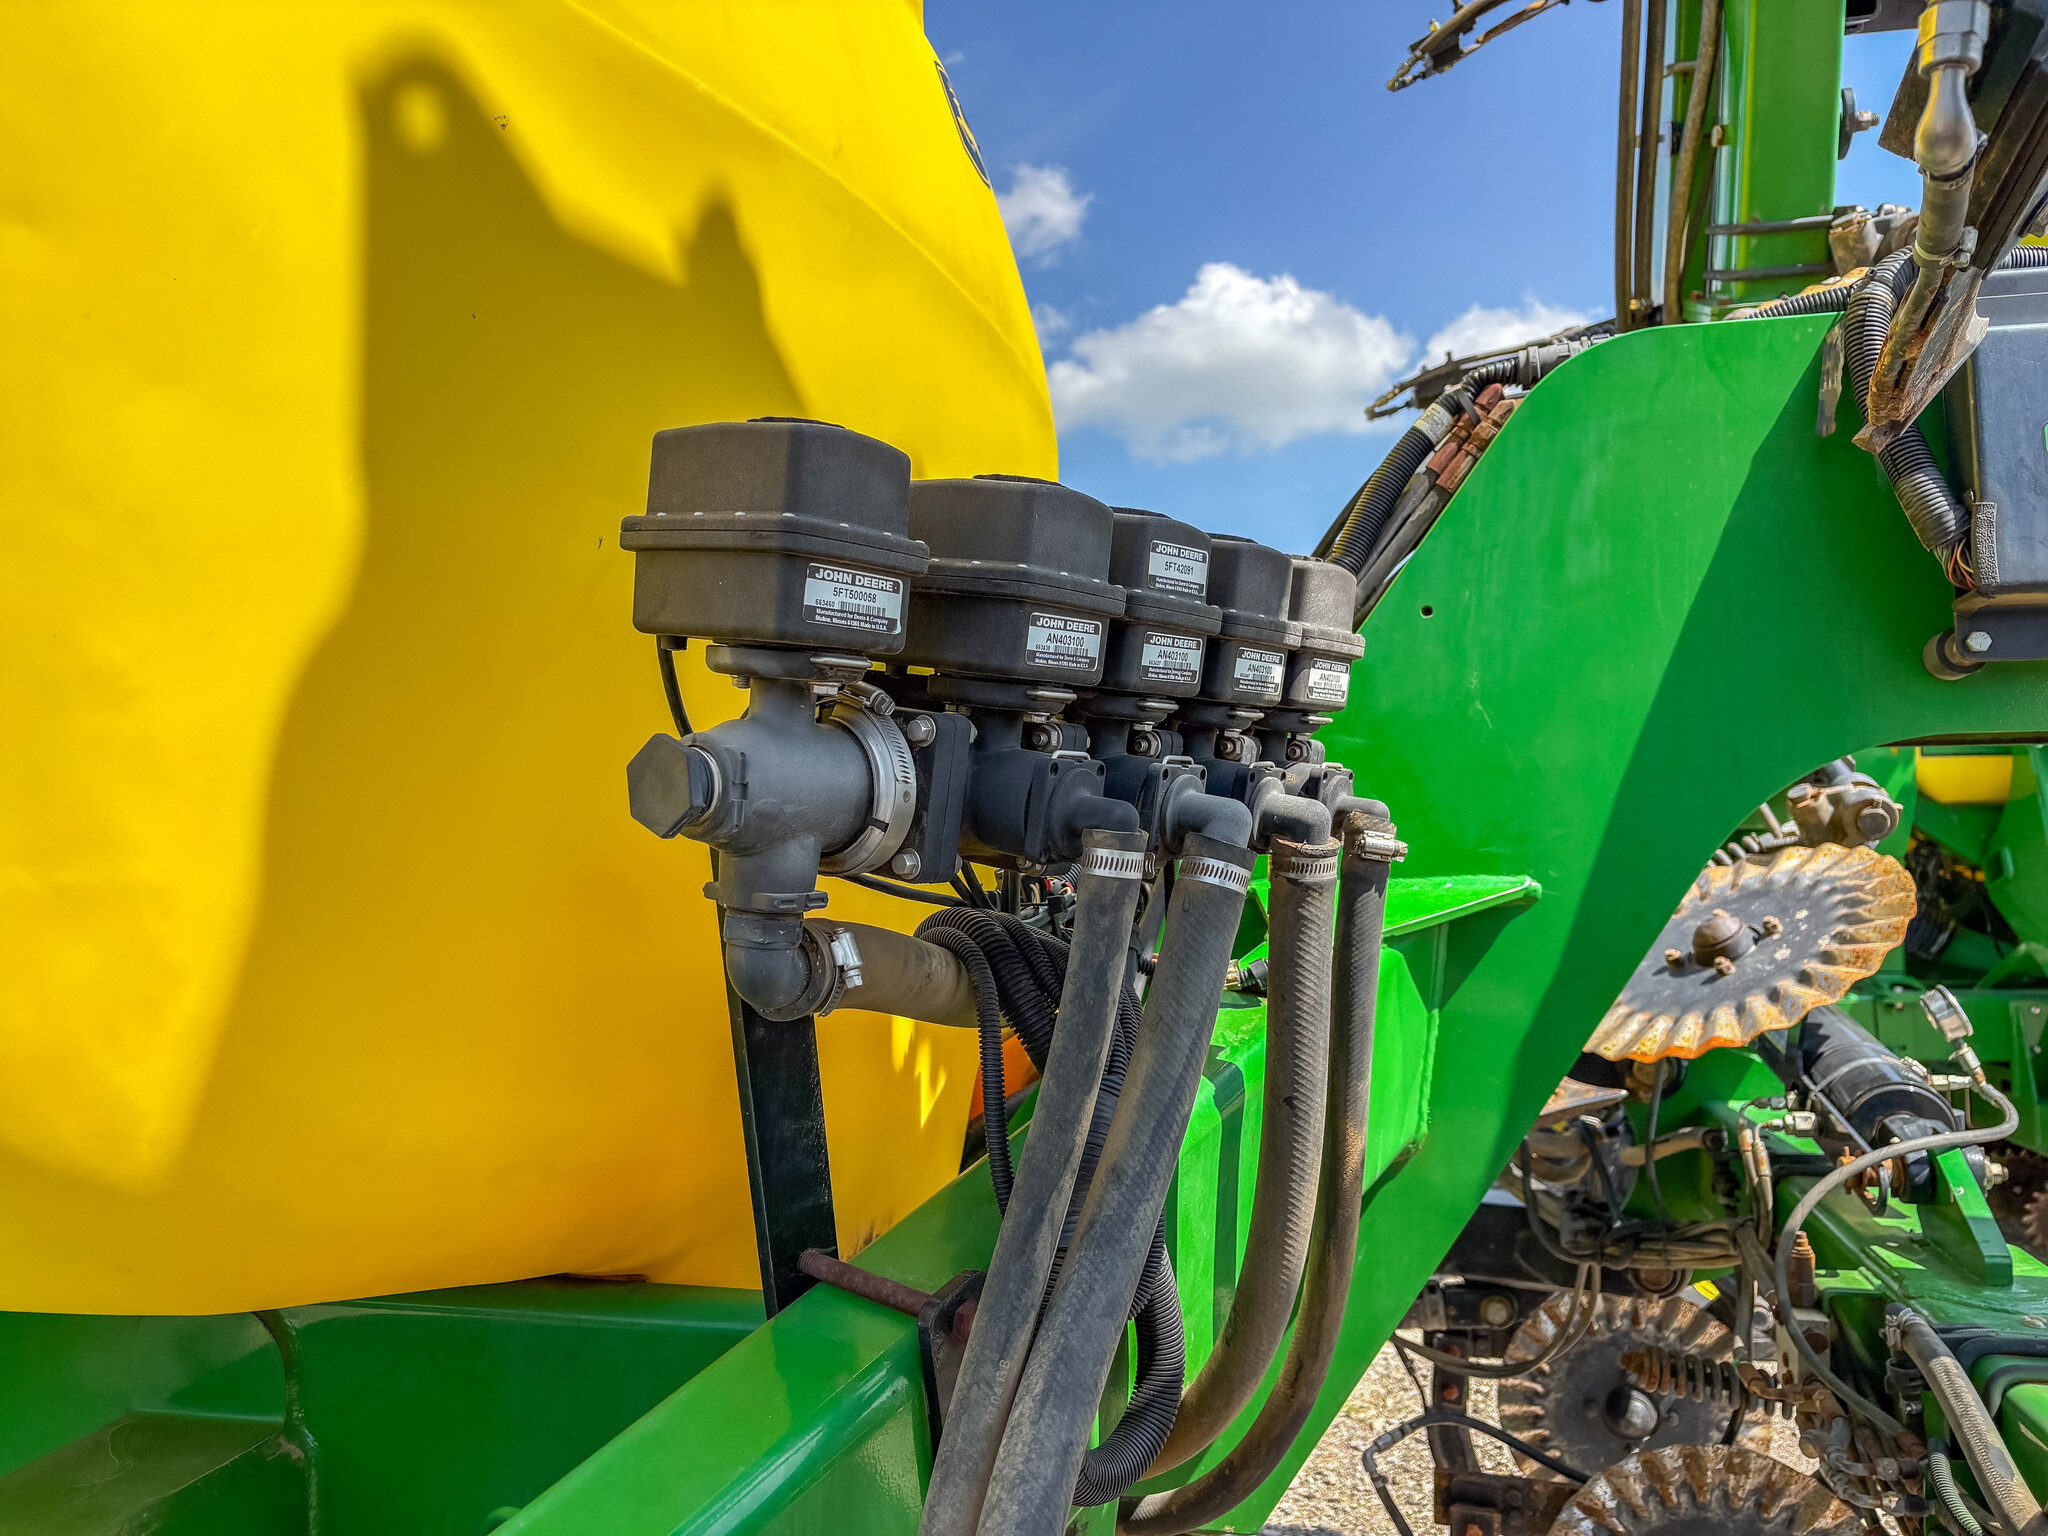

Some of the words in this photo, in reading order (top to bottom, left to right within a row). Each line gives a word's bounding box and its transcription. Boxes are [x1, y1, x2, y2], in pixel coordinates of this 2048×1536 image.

[1155, 544, 1179, 556] JOHN
[1180, 549, 1204, 561] DEERE
[1164, 561, 1194, 576] 5FT42091
[815, 568, 852, 584] JOHN
[855, 575, 894, 592] DEERE
[832, 586, 877, 603] 5FT500058
[1036, 617, 1064, 629] JOHN
[1066, 622, 1095, 634] DEERE
[1046, 632, 1084, 648] AN403100
[1150, 636, 1173, 646] JOHN
[1174, 638, 1198, 649] DEERE
[1157, 649, 1188, 662] AN403100
[1241, 650, 1260, 660] JOHN
[1261, 654, 1280, 664] DEERE
[1314, 660, 1331, 670] JOHN
[1331, 664, 1347, 672] DEERE
